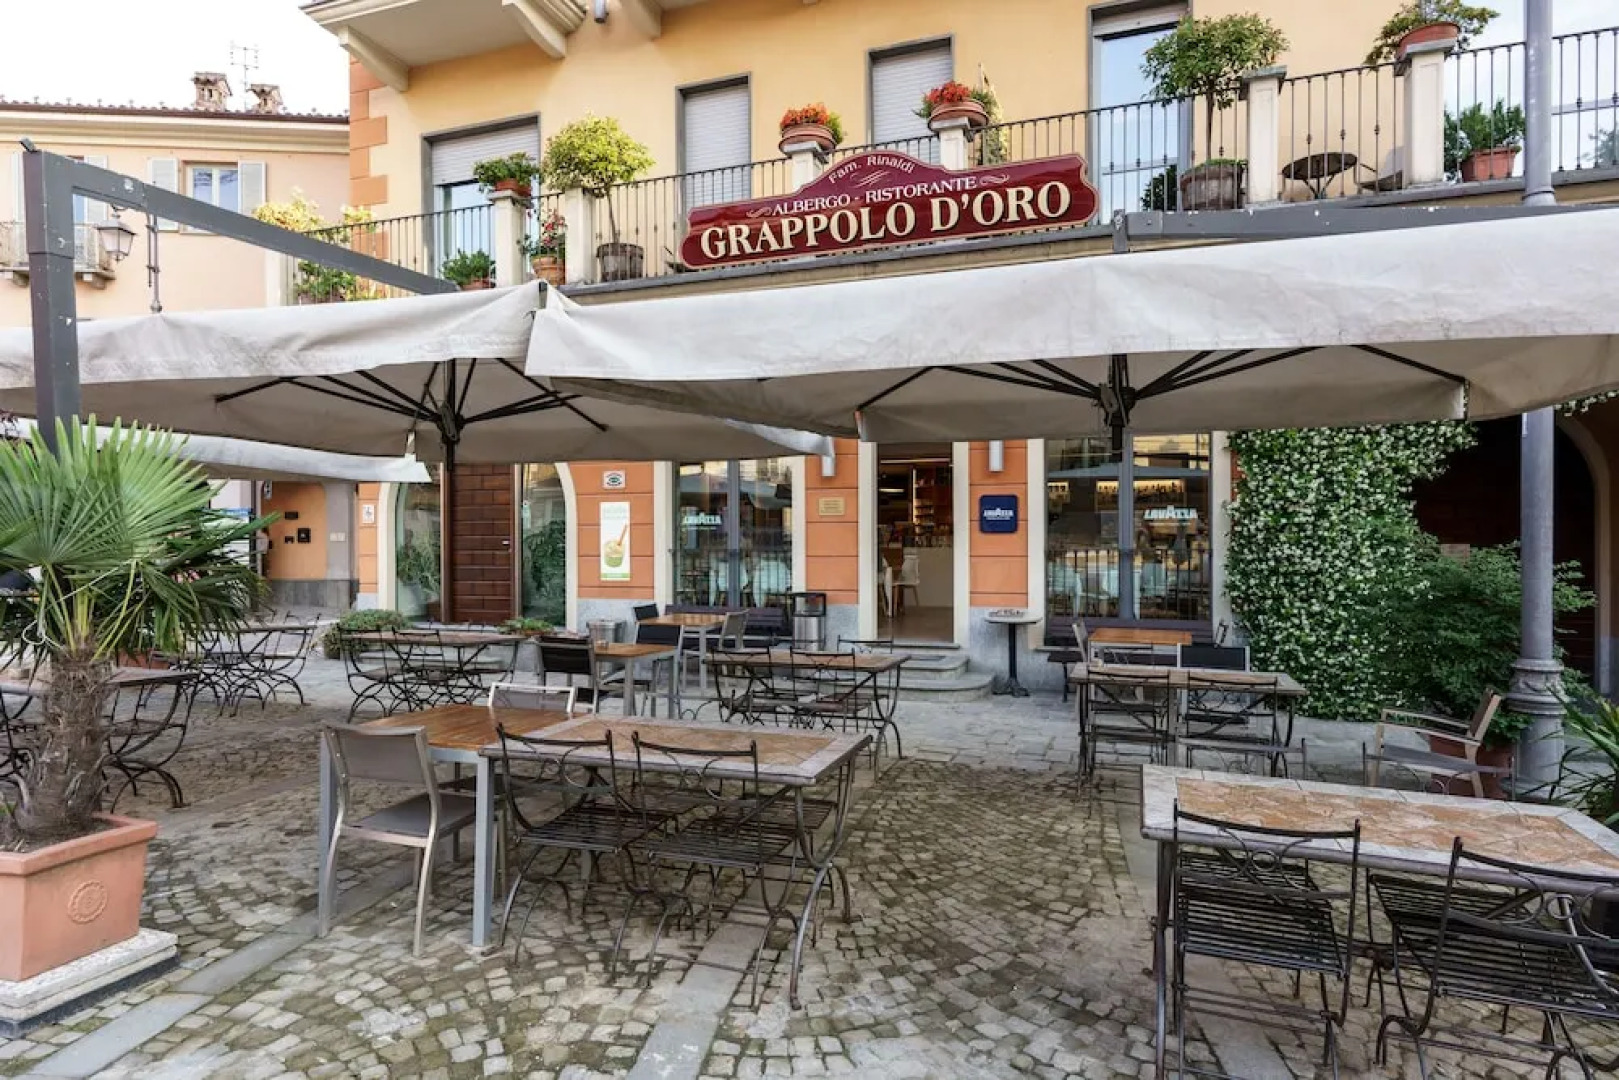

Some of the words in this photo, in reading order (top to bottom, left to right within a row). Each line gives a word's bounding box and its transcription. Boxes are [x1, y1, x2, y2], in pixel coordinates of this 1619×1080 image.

[828, 162, 862, 183] Fam.
[867, 156, 916, 174] Rinaldi
[772, 194, 851, 216] ALBERGO
[866, 176, 977, 203] RISTORANTE
[701, 201, 915, 259] GRAPPOLO
[930, 181, 1071, 232] D'ORO
[1143, 504, 1199, 519] LAVAZZA
